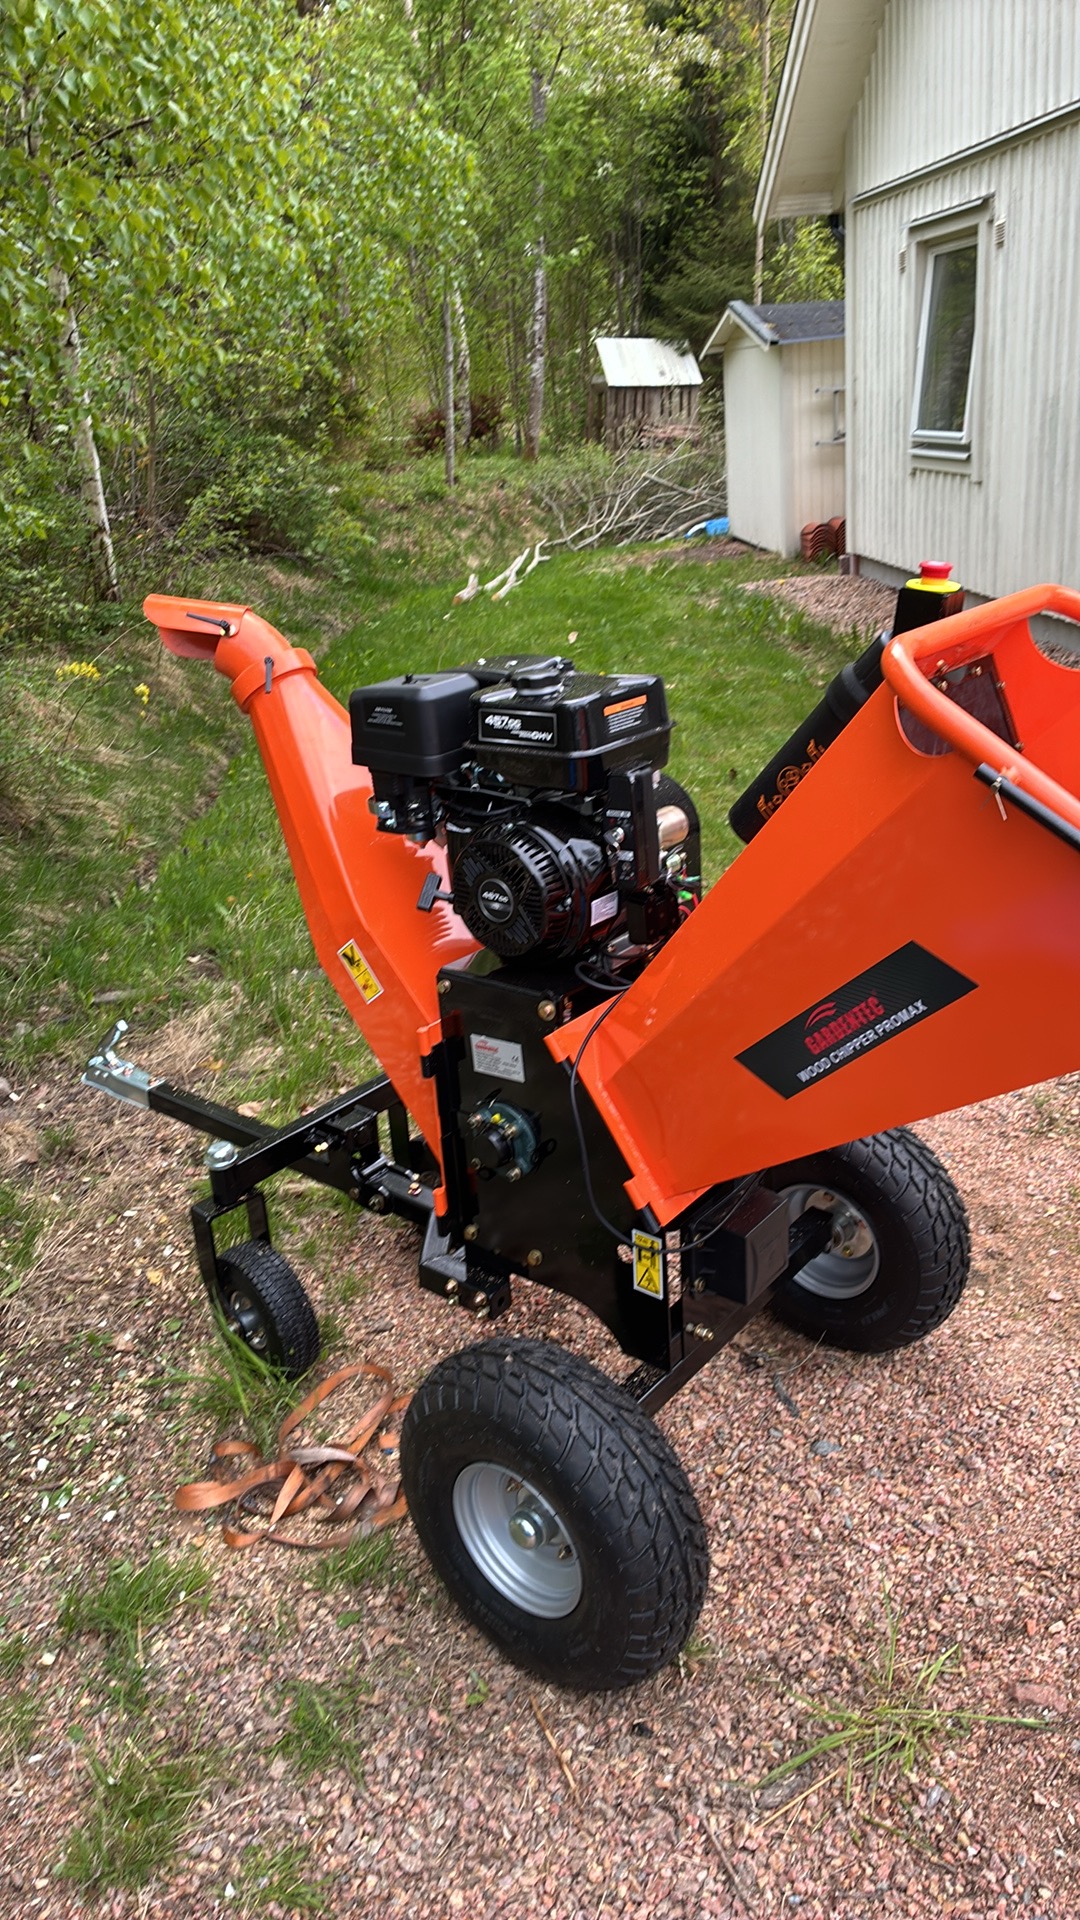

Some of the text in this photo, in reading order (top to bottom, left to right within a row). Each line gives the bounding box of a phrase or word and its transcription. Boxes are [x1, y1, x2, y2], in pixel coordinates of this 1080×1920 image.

[796, 999, 928, 1083] WOOD CHIPPER PROMAX
[804, 996, 885, 1055] GARDENTEC
